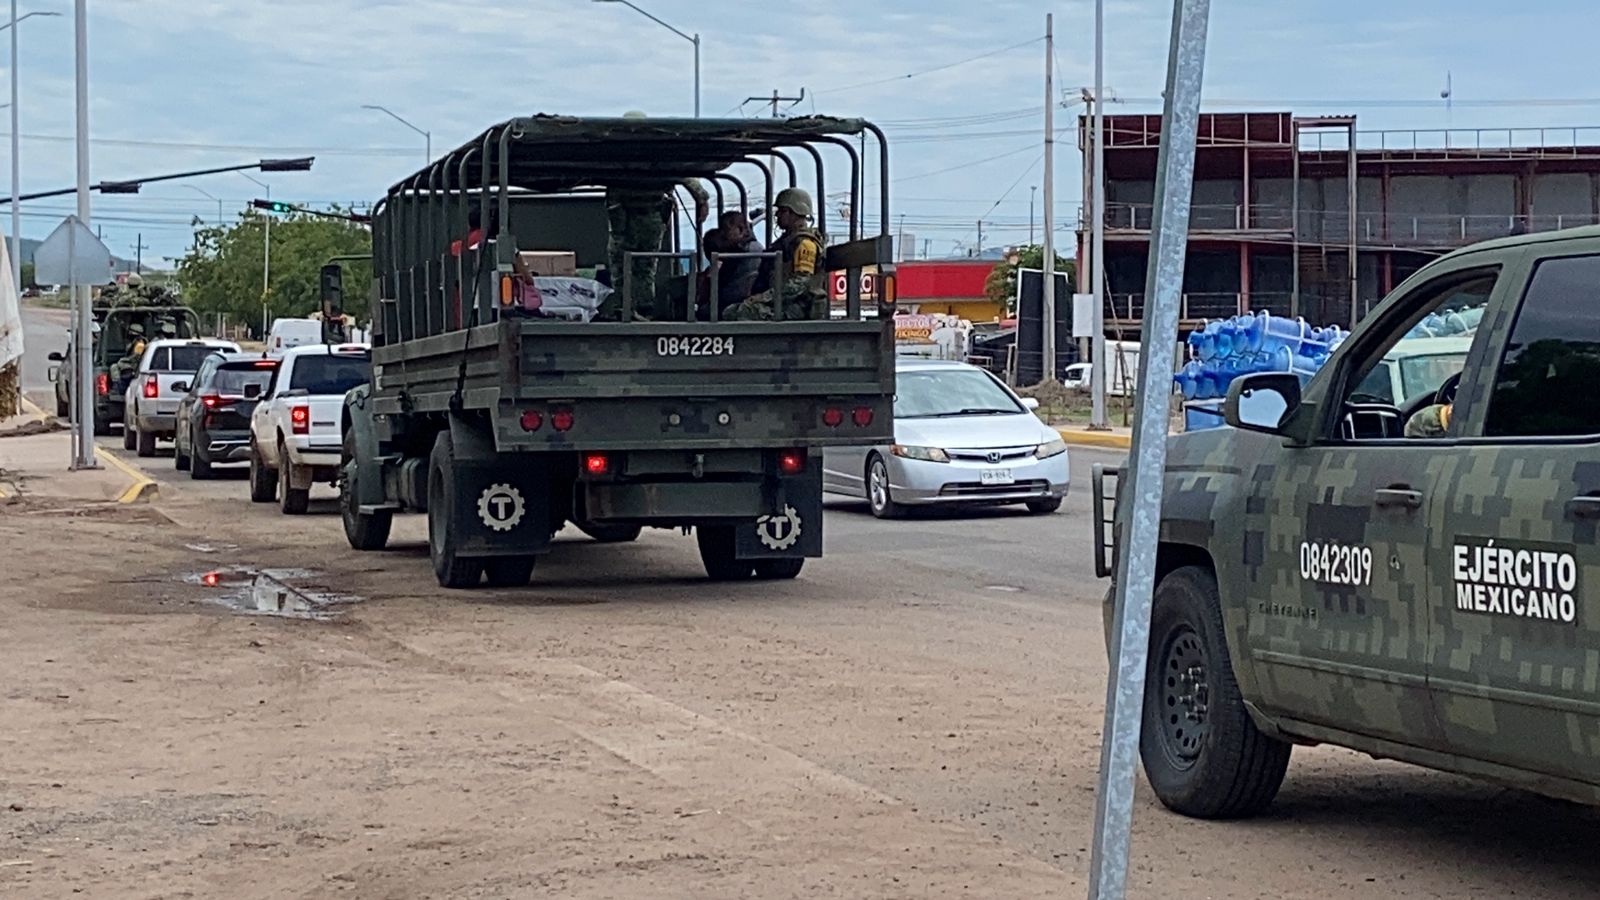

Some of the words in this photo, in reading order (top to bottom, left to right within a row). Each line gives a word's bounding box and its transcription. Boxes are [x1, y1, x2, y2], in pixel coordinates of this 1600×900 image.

[657, 336, 734, 356] 0842284
[1300, 542, 1372, 586] 0842309
[1453, 539, 1577, 592] EJÉRCITO
[1456, 583, 1576, 623] MEXICANO
